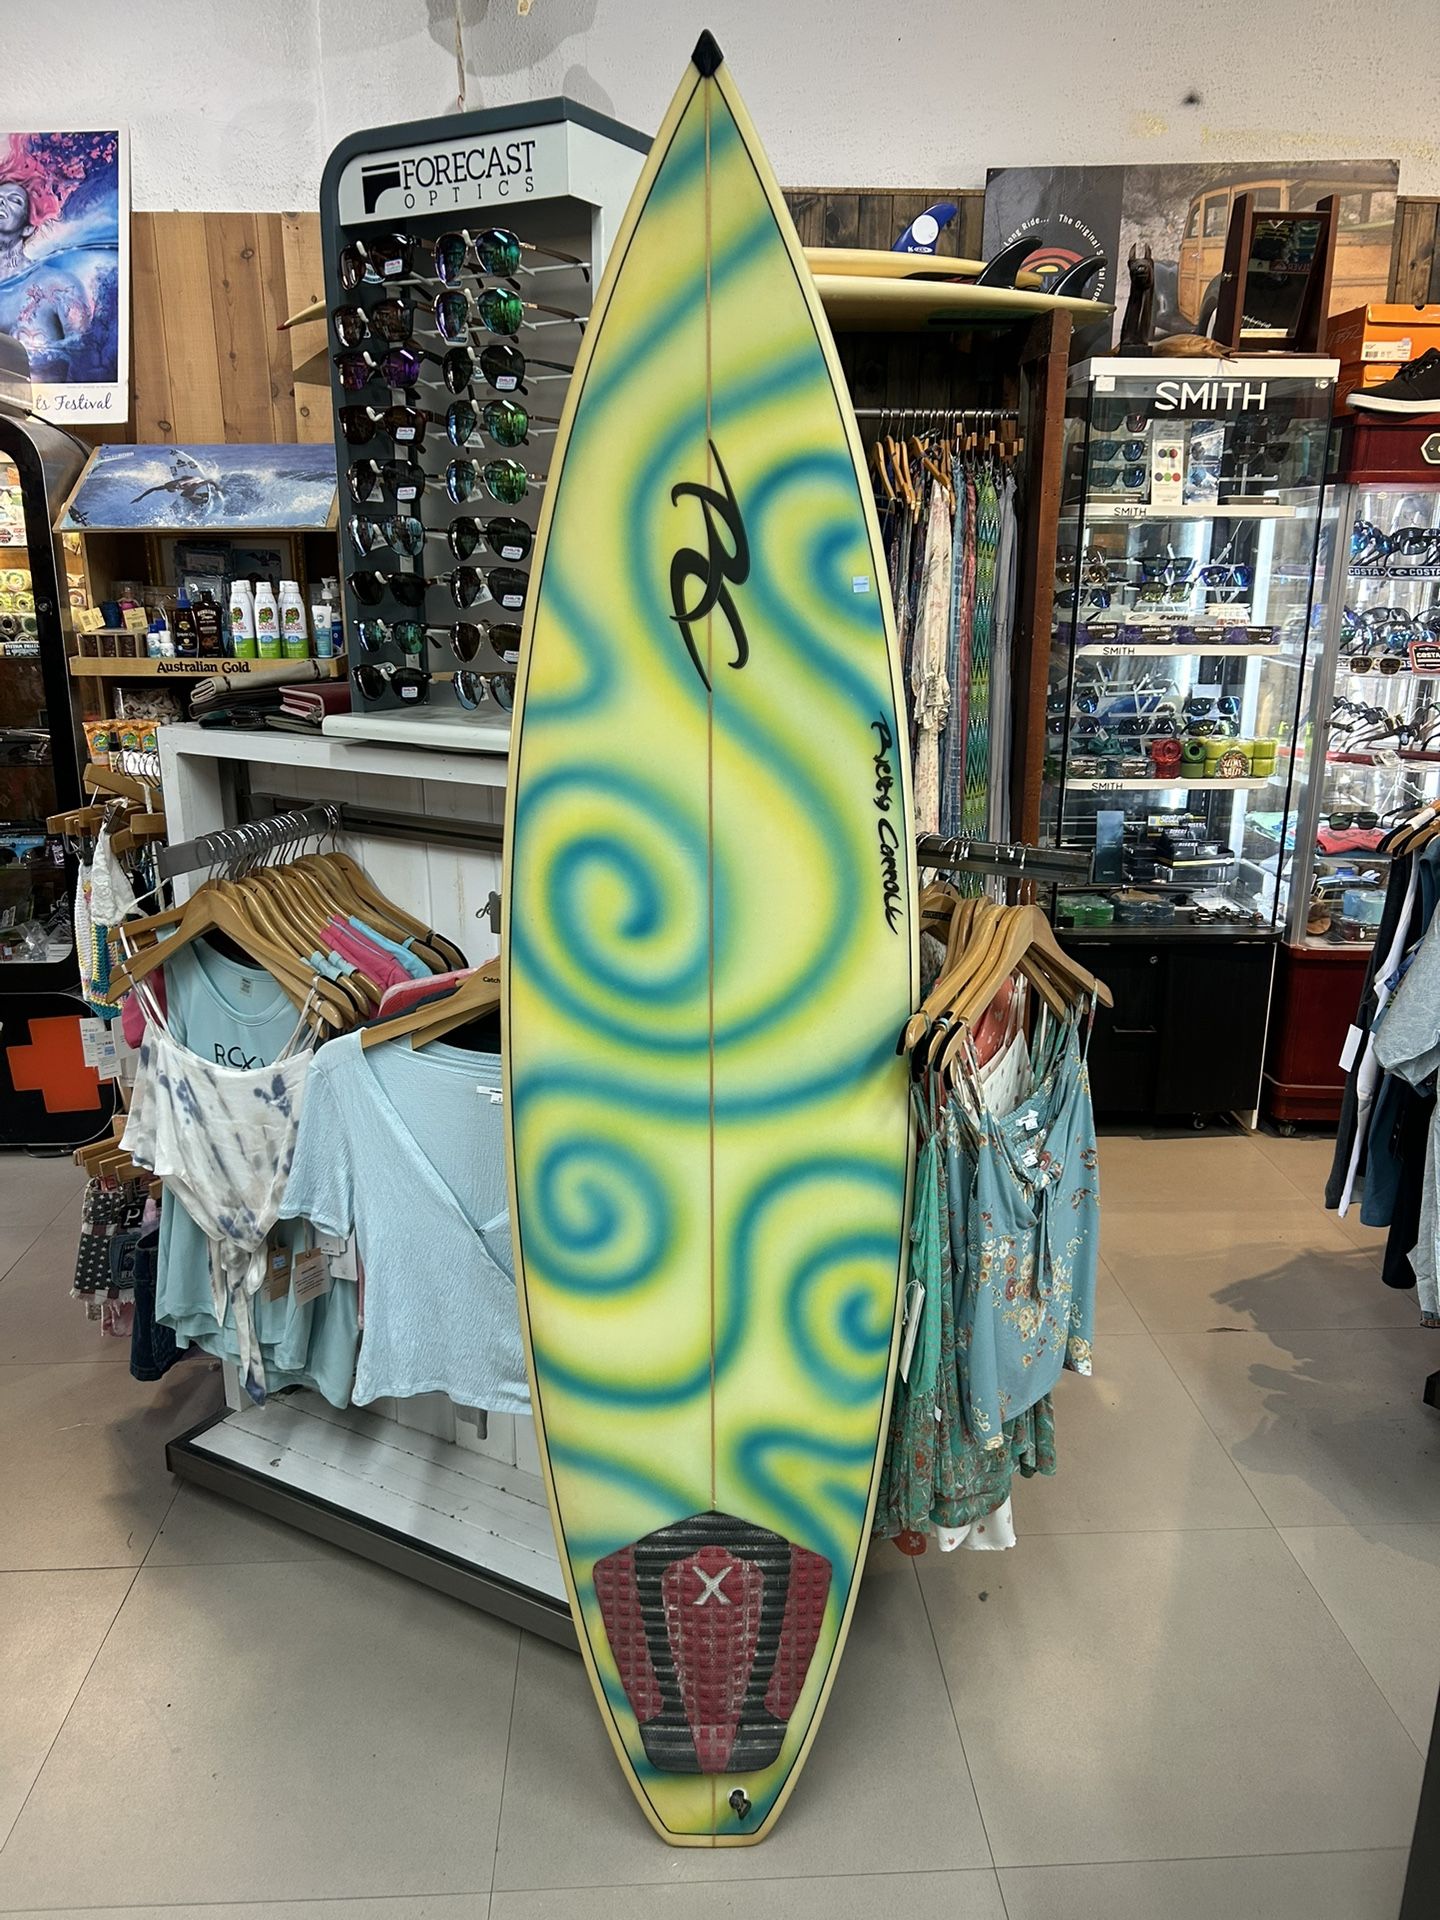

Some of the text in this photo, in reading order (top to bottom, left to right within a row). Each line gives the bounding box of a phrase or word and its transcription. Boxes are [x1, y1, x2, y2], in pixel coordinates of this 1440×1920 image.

[402, 141, 536, 190] FORECAST
[404, 177, 534, 209] OPTICS
[1003, 229, 1022, 247] Long
[1059, 214, 1073, 225] The
[1074, 220, 1101, 249] Original
[54, 391, 113, 411] Festival
[1154, 381, 1268, 411] SMITH
[1113, 507, 1147, 517] SMITH
[1348, 567, 1440, 577] COSTA COSTA
[1102, 646, 1136, 656] SMITH
[157, 661, 251, 674] Australian Gold
[1091, 782, 1123, 791] SMITH
[482, 976, 500, 984] Catch
